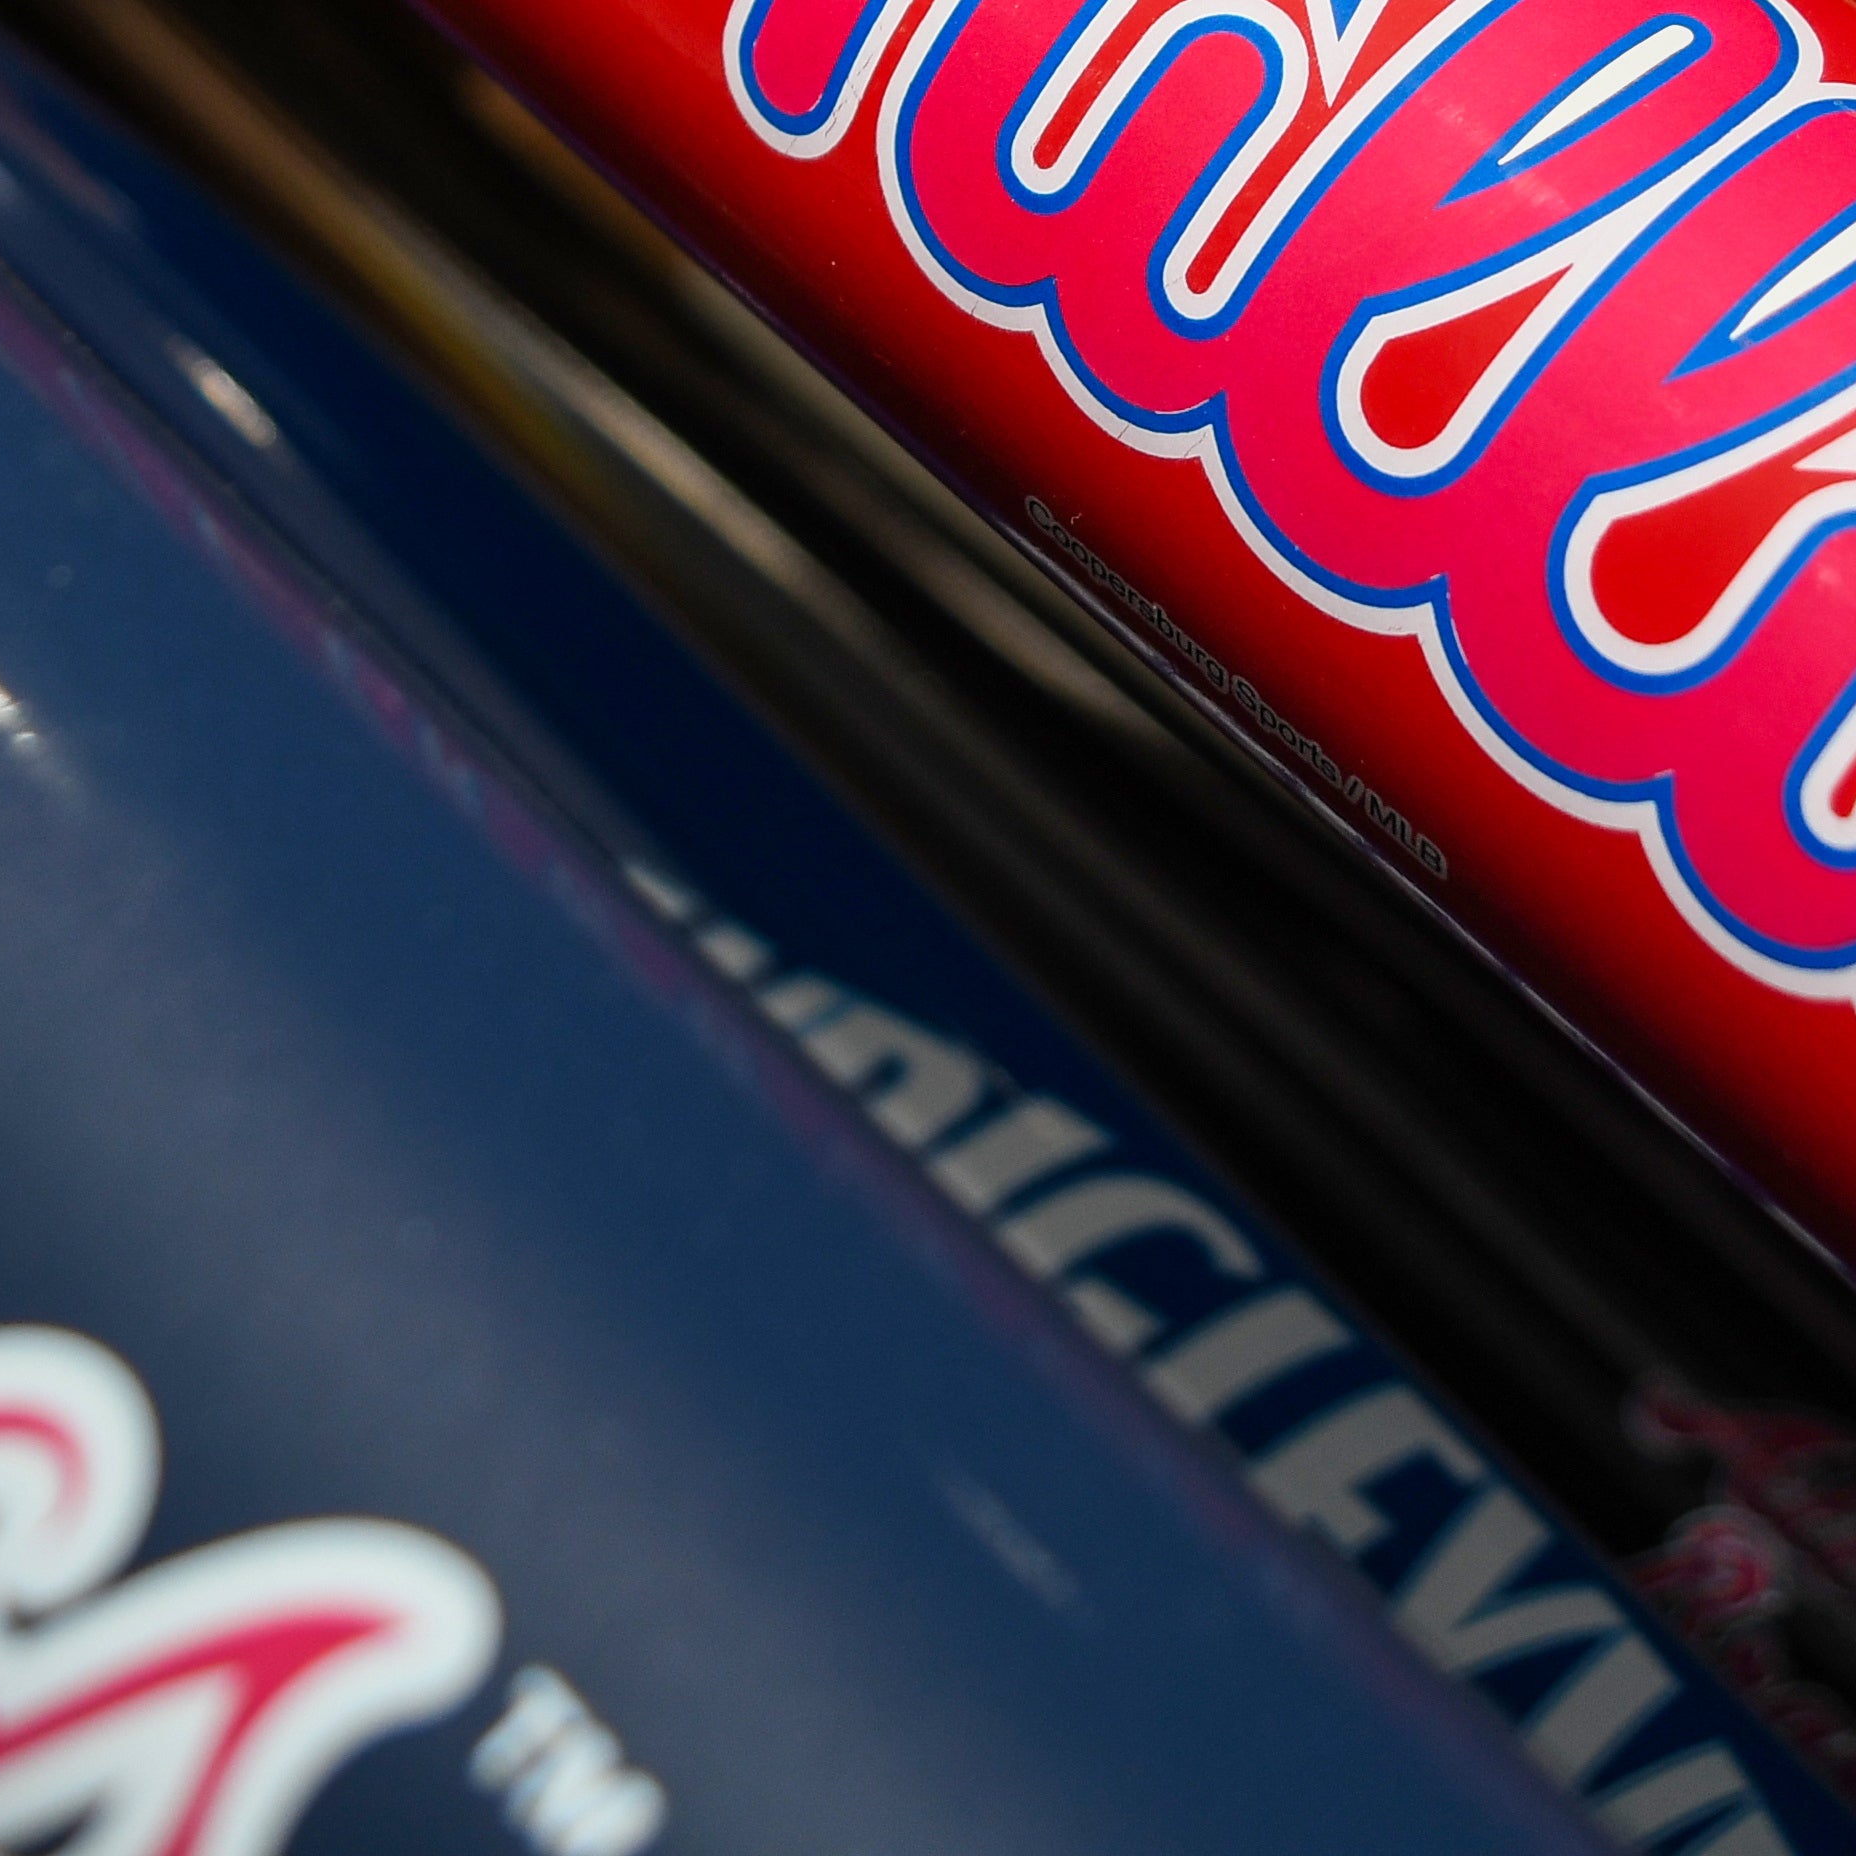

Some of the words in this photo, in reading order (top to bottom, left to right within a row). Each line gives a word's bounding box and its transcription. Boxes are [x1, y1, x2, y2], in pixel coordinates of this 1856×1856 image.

[1026, 498, 1228, 692] Coopersburg
[1233, 678, 1341, 784] Sports
[1367, 793, 1446, 876] MLB
